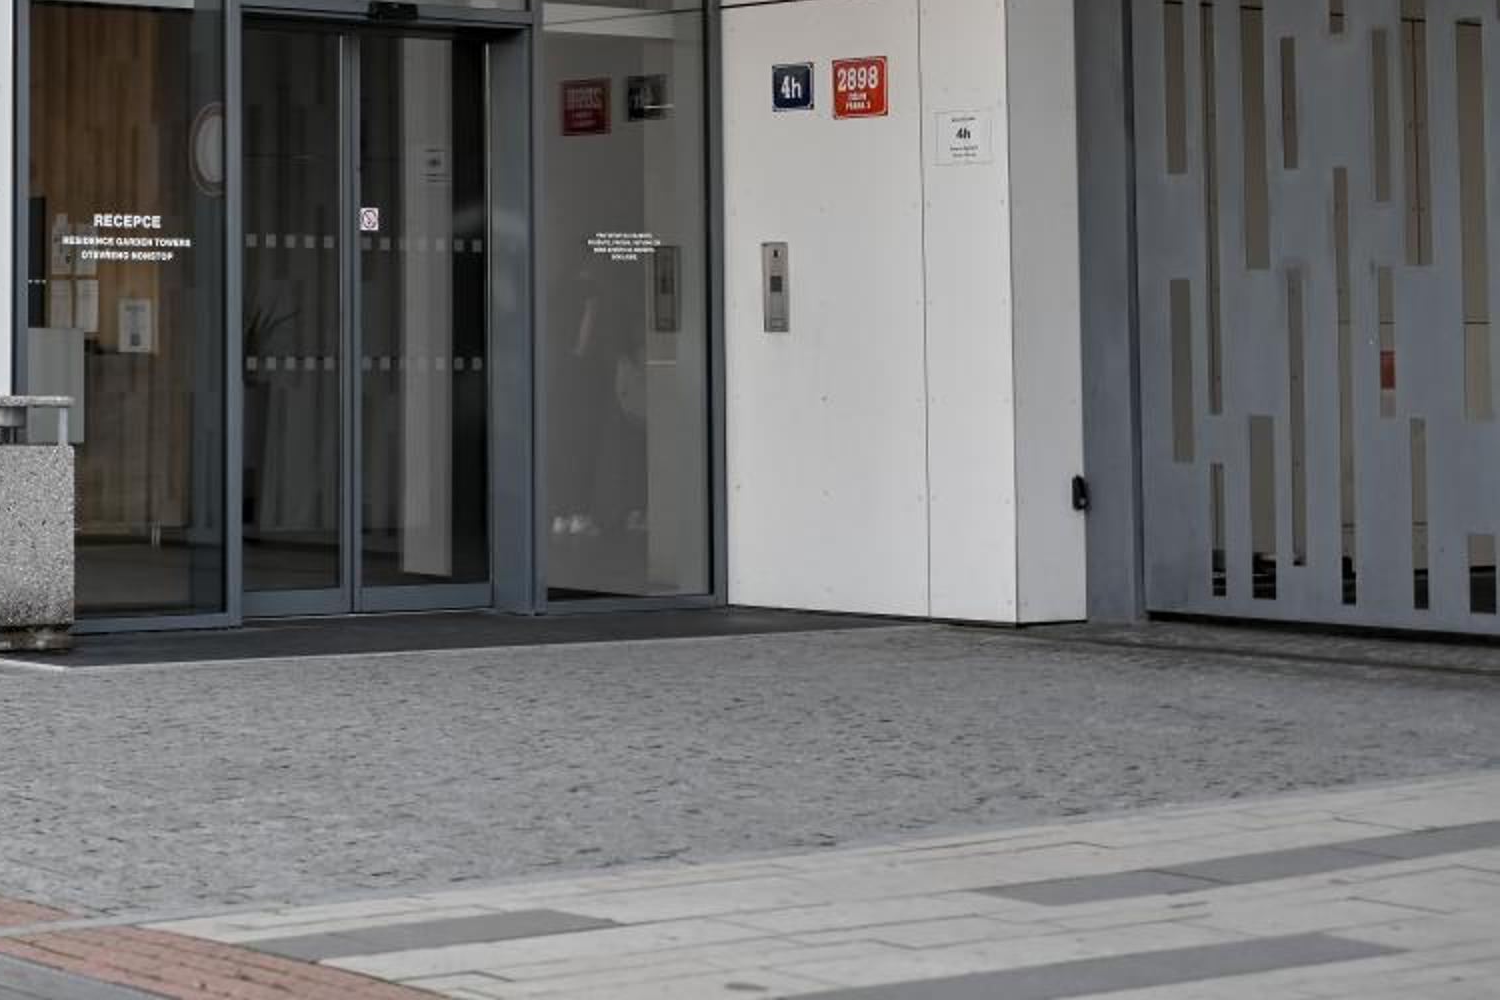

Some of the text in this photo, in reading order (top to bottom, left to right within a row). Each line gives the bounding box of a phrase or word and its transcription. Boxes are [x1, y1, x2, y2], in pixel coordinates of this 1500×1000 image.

[781, 75, 803, 99] 4h
[837, 65, 879, 93] 2898
[956, 127, 971, 139] 4h
[93, 213, 162, 229] RECEPCE
